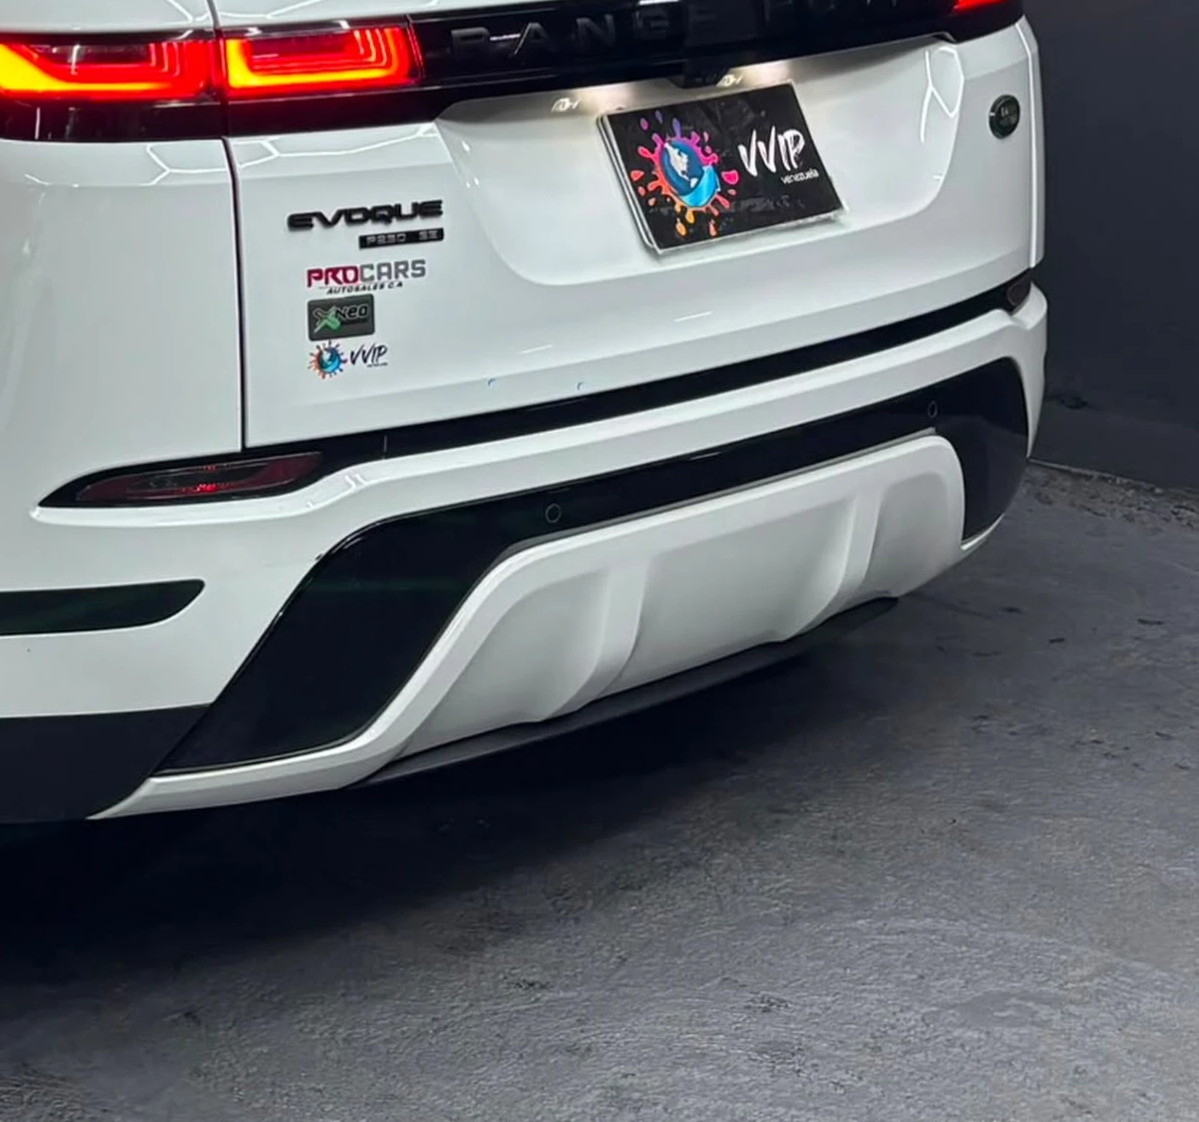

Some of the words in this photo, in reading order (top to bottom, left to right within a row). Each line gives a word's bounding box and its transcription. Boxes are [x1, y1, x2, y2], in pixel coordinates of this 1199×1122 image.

[738, 126, 805, 176] VVIP
[287, 200, 443, 231] EVOQUE
[307, 259, 426, 288] PROCARS
[350, 343, 388, 365] VVIP
